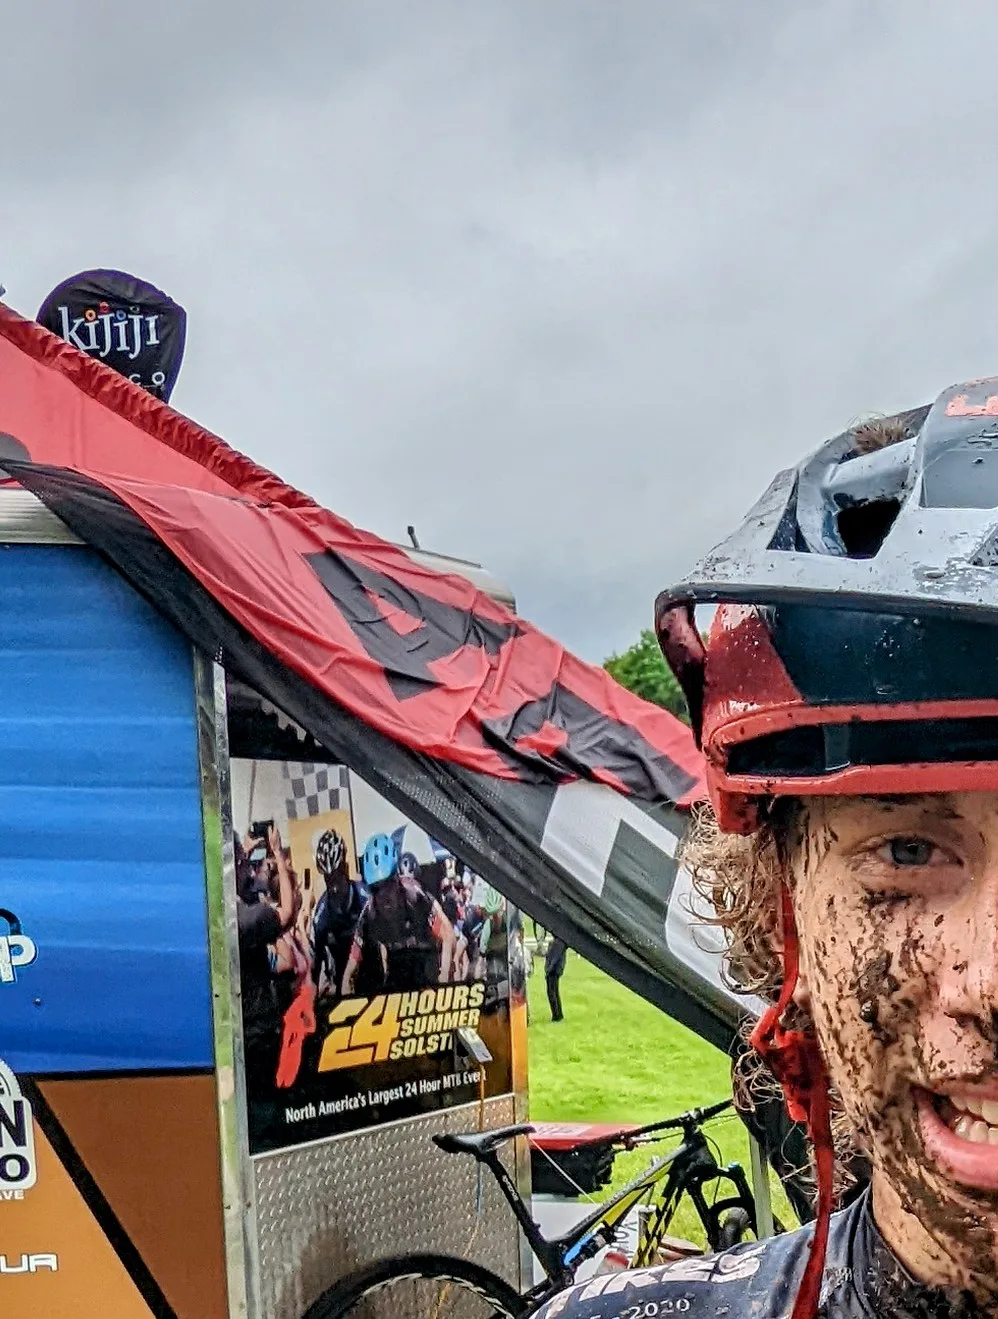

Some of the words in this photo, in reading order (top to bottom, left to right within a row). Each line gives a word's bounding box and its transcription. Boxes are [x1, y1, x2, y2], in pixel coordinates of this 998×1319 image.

[318, 993, 400, 1073] 24
[400, 983, 486, 1018] HOURS
[400, 1008, 481, 1037] SUMMER
[389, 1032, 454, 1061] SOLSTI
[285, 1101, 317, 1124] North
[318, 1092, 367, 1117] America's
[368, 1083, 404, 1106] Largest
[405, 1082, 417, 1097] 24
[419, 1075, 441, 1094] Hour
[443, 1072, 461, 1089] MTB
[463, 1070, 487, 1085] Evet
[0, 1154, 30, 1182] O
